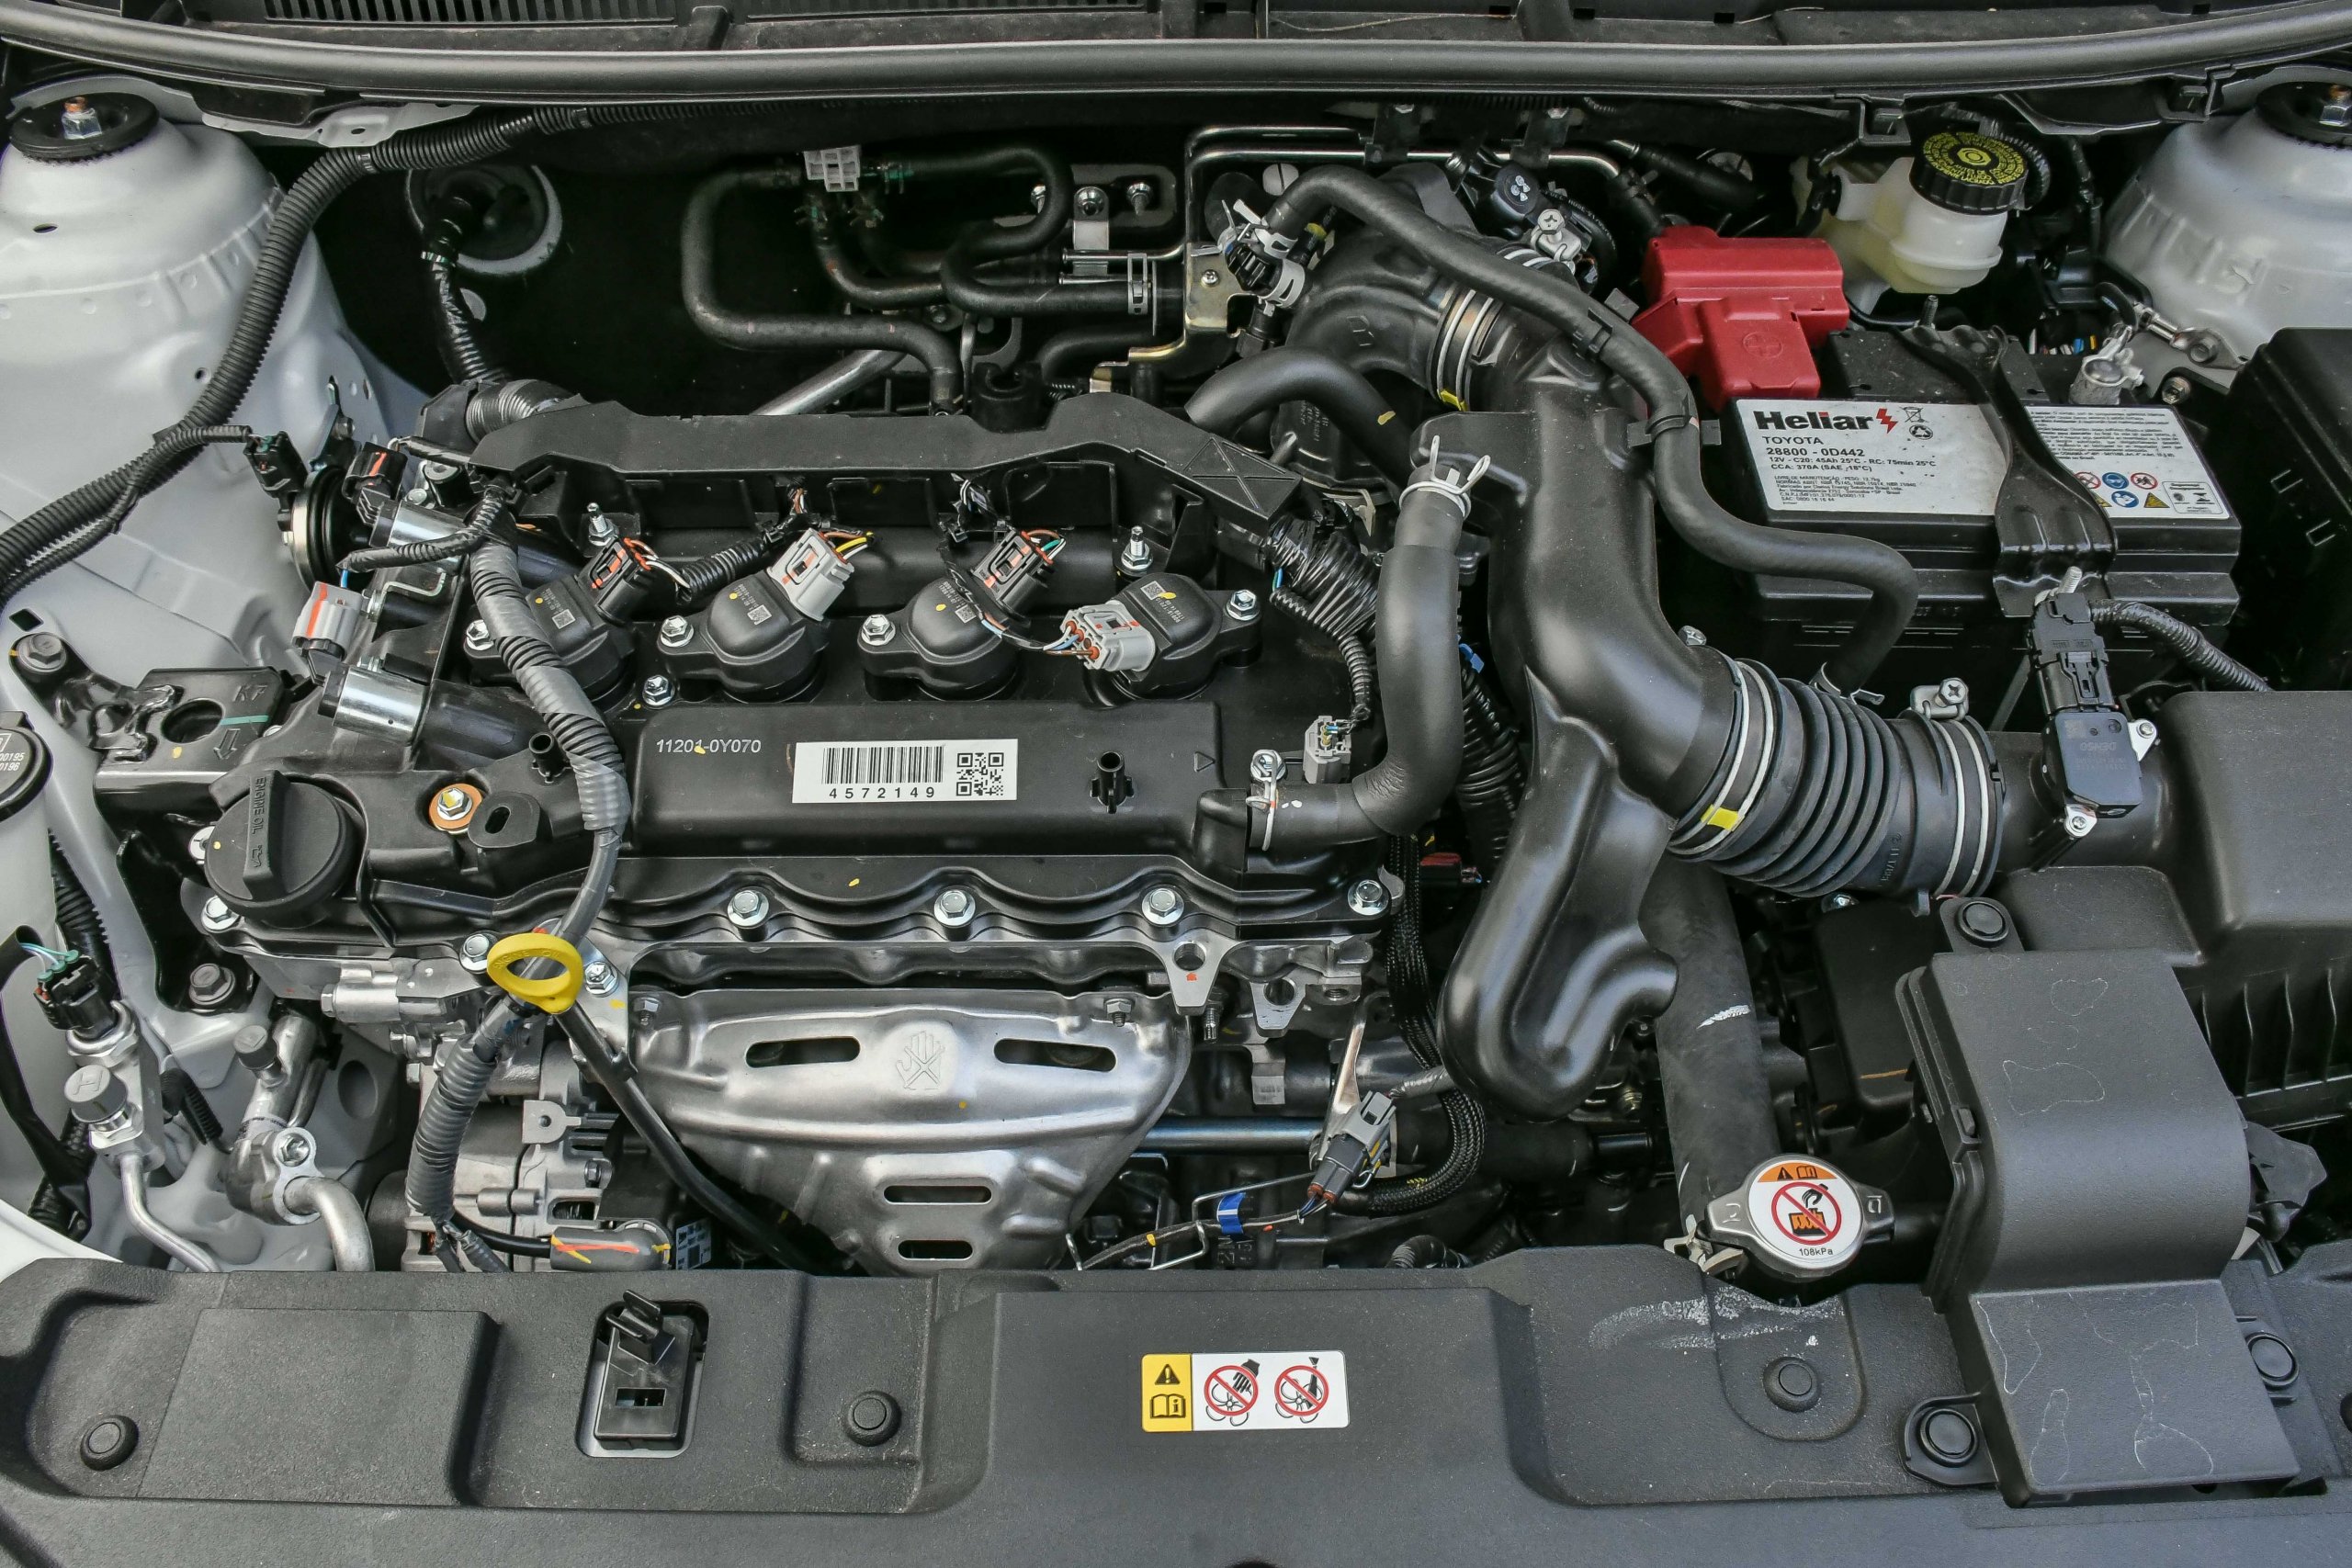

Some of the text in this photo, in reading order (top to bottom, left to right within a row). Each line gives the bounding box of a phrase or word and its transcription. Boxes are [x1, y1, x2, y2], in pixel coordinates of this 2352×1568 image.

[1753, 411, 1873, 431] Heliar
[1762, 436, 1824, 445] TOYOTA
[1767, 447, 1807, 457] 28800
[1821, 448, 1865, 457] 0D442
[655, 739, 762, 754] 11201-0Y070
[252, 776, 266, 835] ENGINE OIL
[1798, 1247, 1833, 1257] 108kPa
